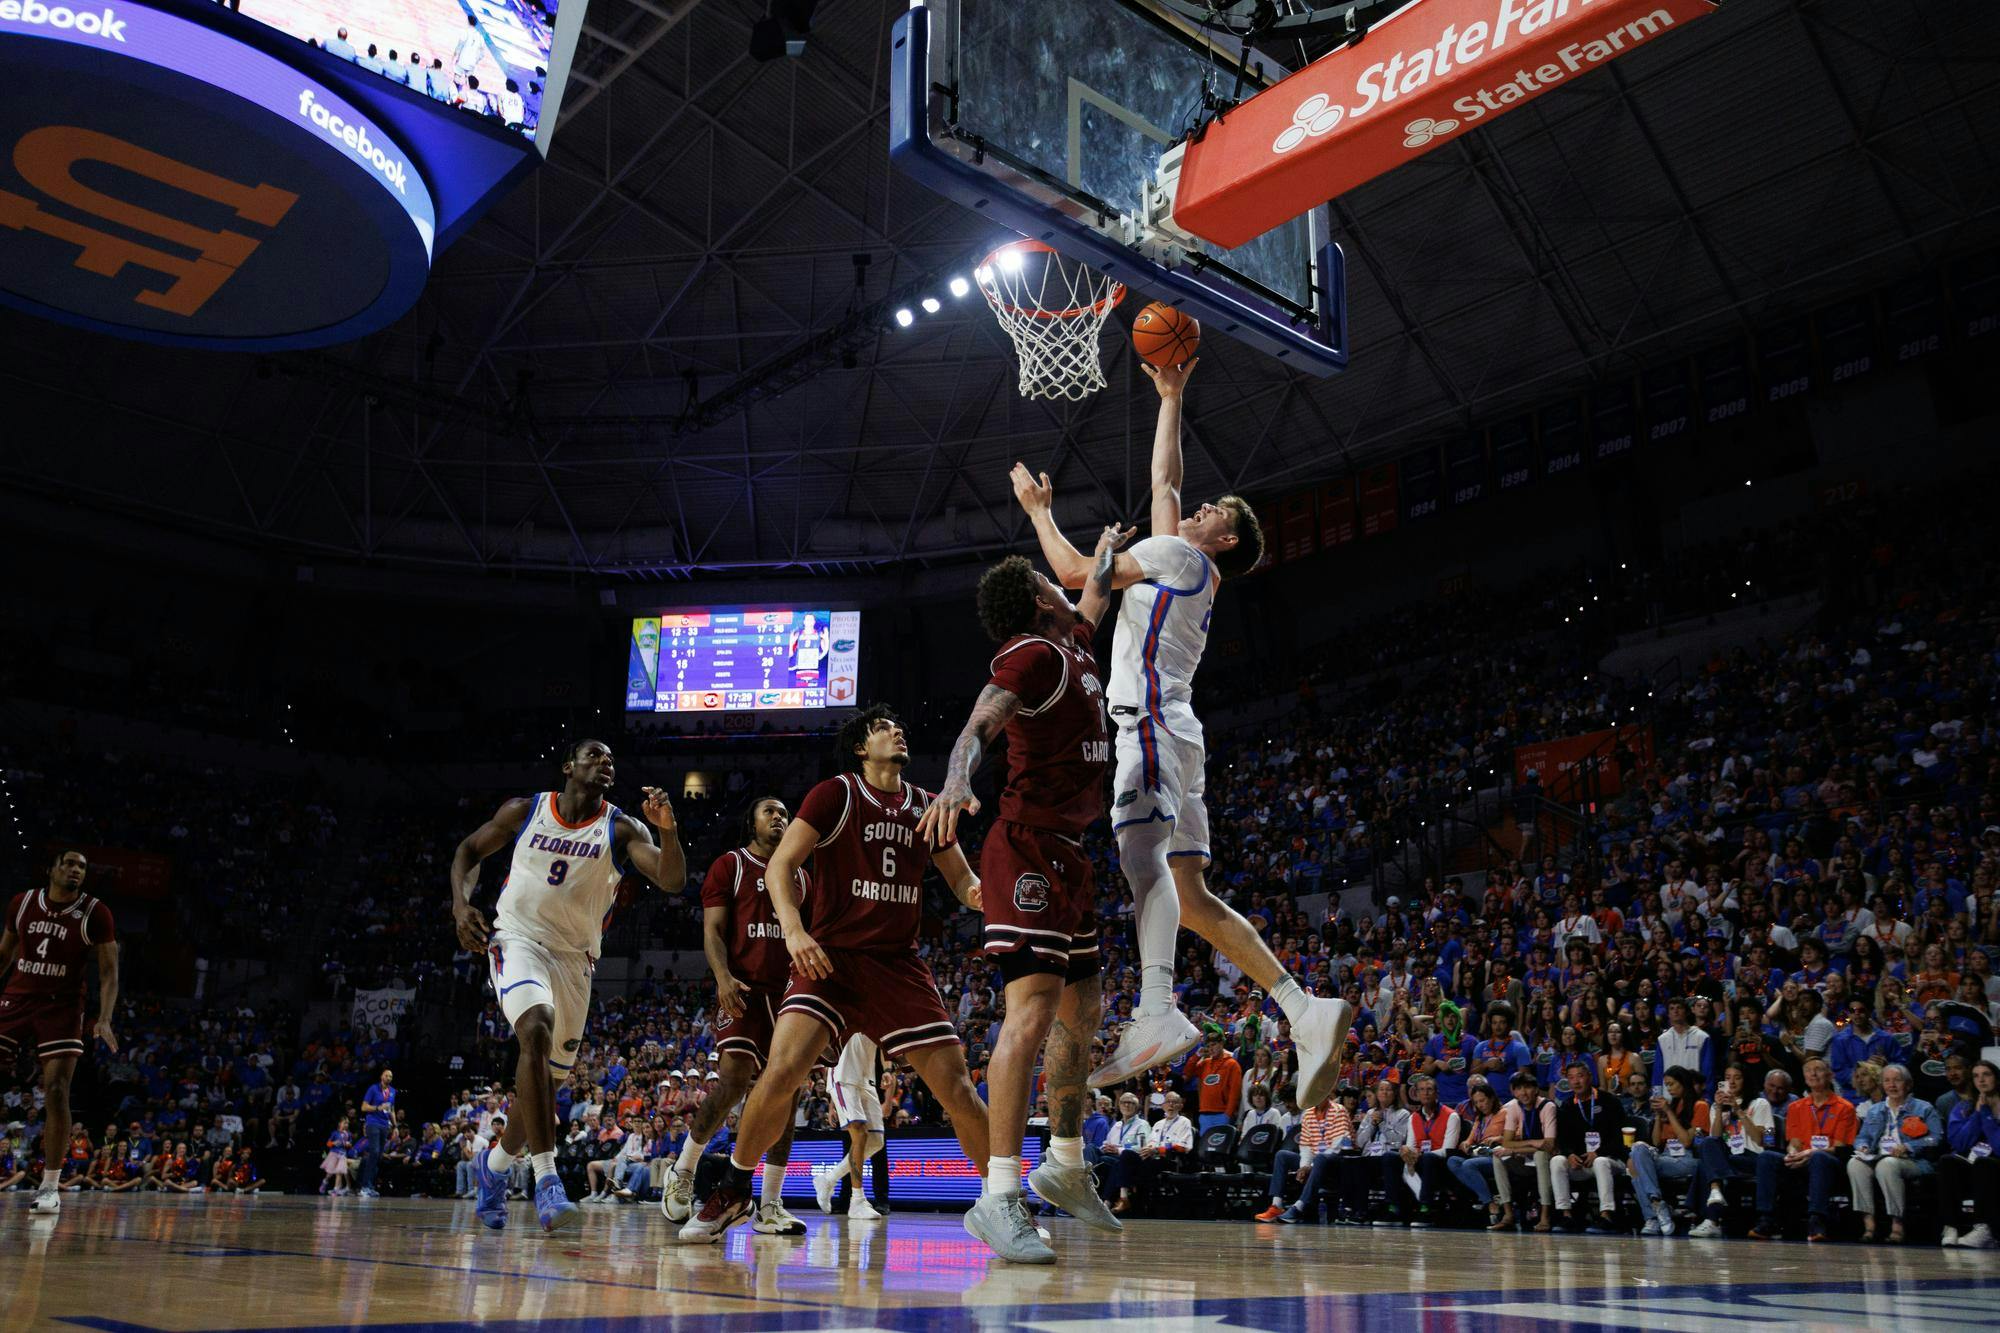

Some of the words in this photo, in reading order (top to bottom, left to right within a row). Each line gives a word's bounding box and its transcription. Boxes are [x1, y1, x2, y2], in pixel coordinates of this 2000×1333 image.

[299, 89, 406, 195] facebook
[0, 125, 299, 317] UF
[1899, 335, 1940, 361] 2012
[1832, 355, 1871, 384] 2010
[1651, 416, 1687, 440] 2007
[1598, 435, 1632, 457] 2006
[1548, 452, 1581, 473] 2004
[682, 694, 697, 707] 31
[782, 691, 801, 704] 44
[529, 833, 601, 859] FLORIDA
[864, 822, 913, 848] SOUTH
[547, 860, 569, 886] 9
[882, 846, 897, 878] 6
[851, 878, 918, 905] CAROLINA
[27, 920, 68, 940] SOUTH
[36, 938, 50, 959] 4
